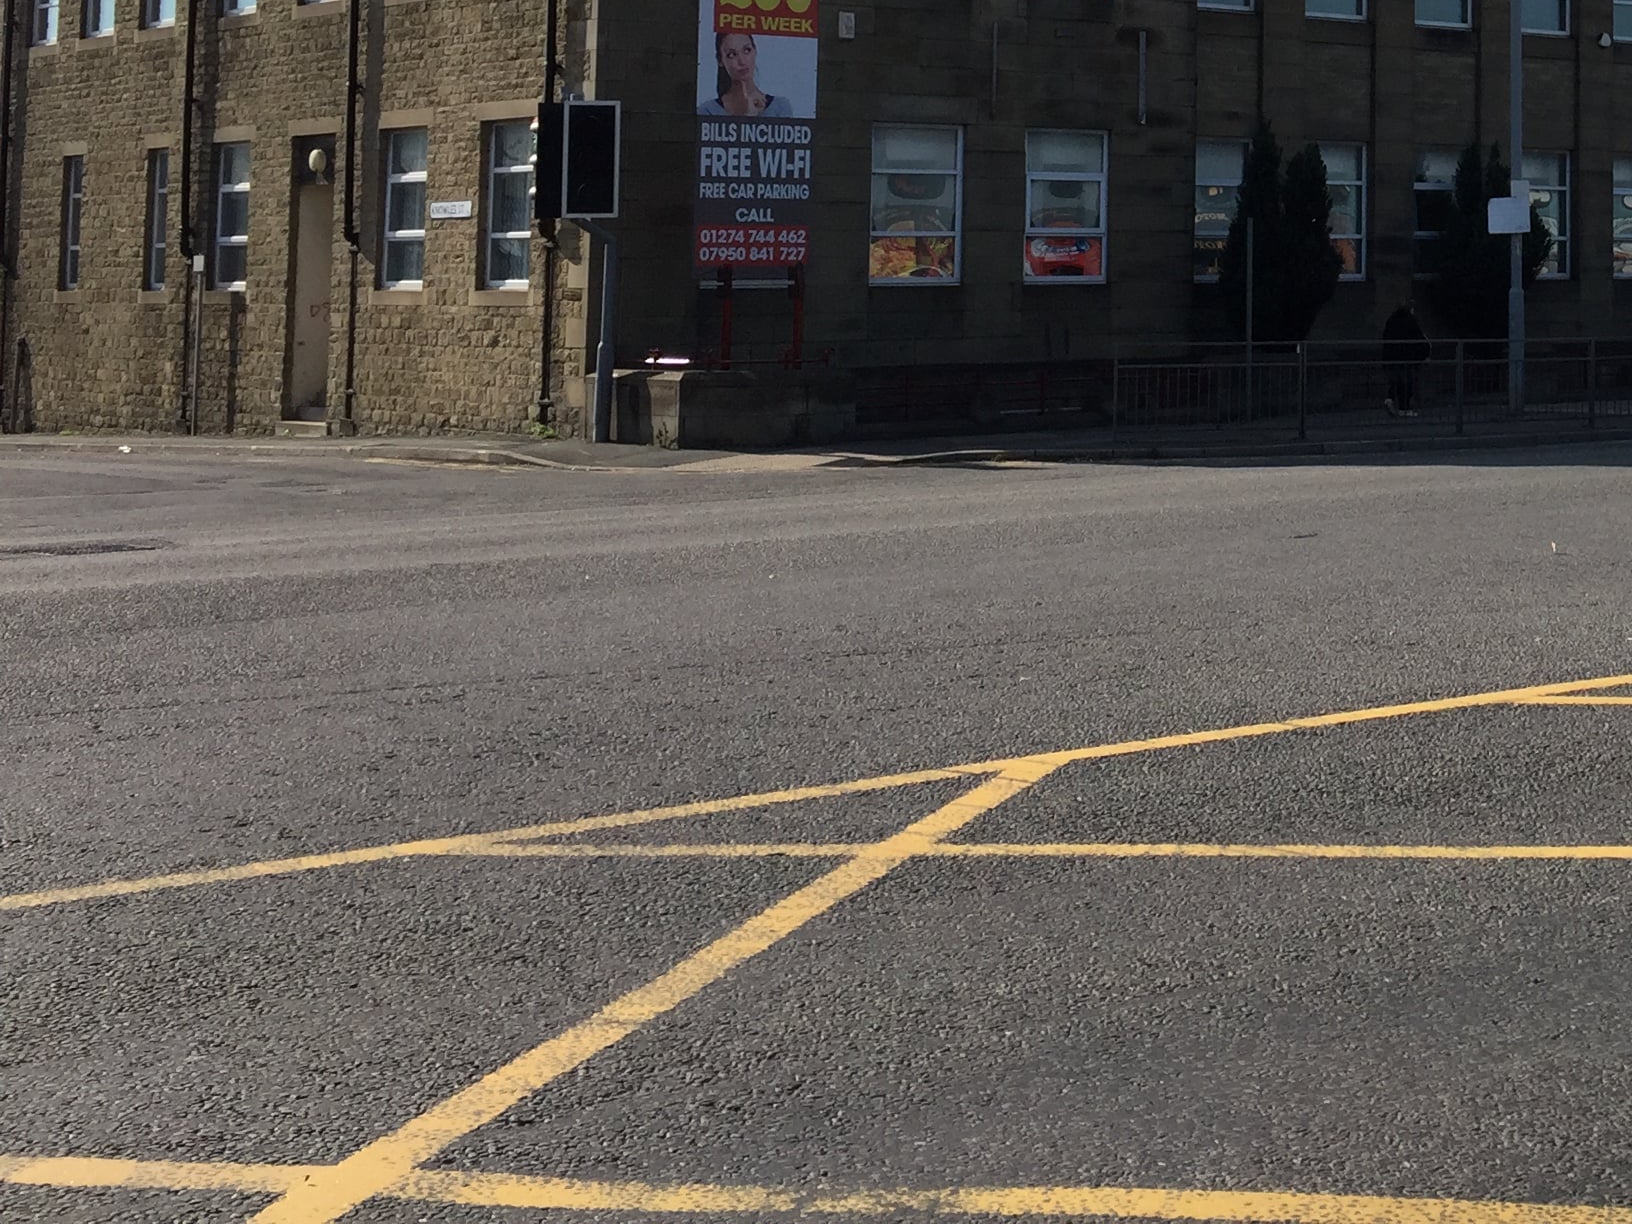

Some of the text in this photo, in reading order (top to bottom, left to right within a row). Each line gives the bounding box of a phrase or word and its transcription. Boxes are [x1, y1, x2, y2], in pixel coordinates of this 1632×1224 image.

[719, 13, 814, 33] PER WEEK
[700, 122, 812, 144] BILLS INCLUDED
[700, 146, 811, 179] FREE WI-FI
[699, 182, 810, 200] FREE CAR PARKING
[735, 207, 775, 223] CALL
[700, 229, 806, 244] 01274 744 462
[700, 247, 805, 261] 07950 841 727
